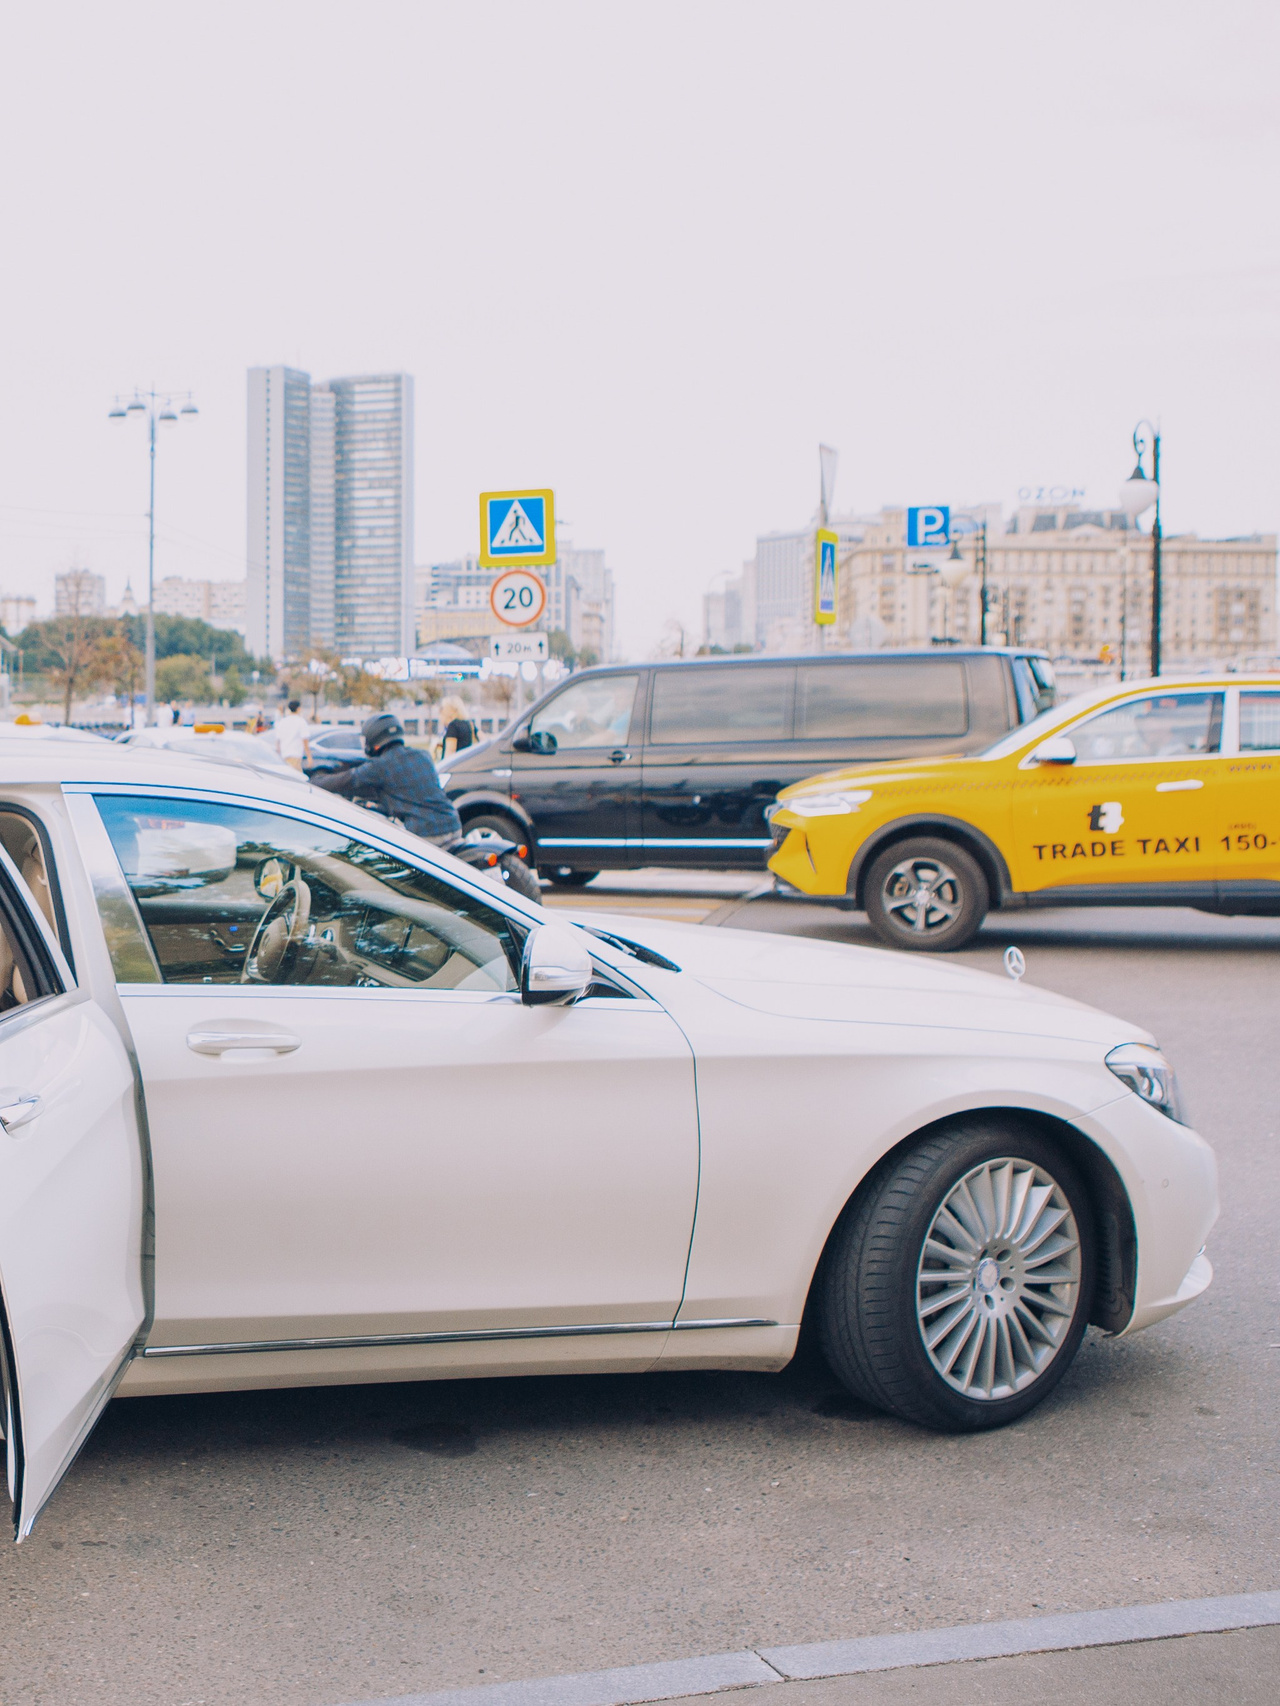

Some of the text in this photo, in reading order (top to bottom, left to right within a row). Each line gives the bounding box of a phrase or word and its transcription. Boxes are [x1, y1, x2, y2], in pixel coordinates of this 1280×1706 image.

[917, 509, 945, 545] P
[503, 587, 533, 609] 20
[1033, 840, 1126, 861] TRADE
[1137, 837, 1201, 855] TAXI
